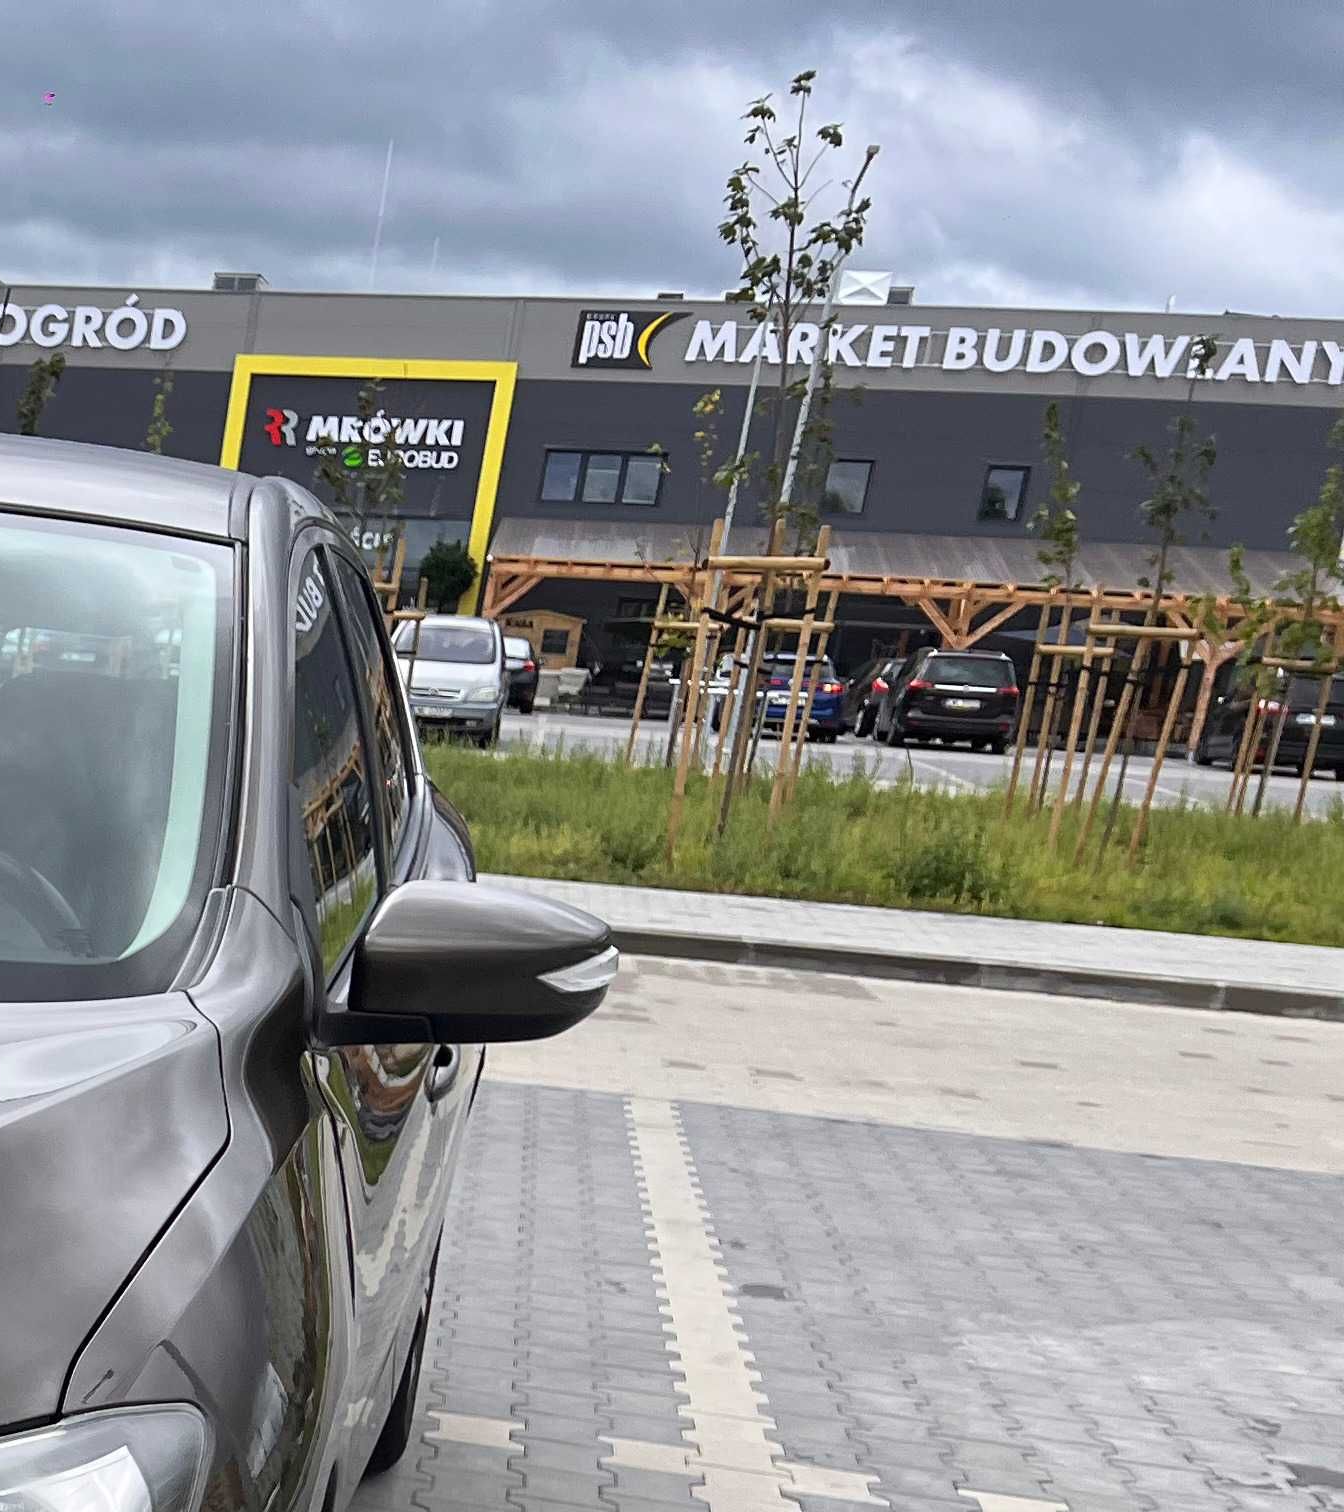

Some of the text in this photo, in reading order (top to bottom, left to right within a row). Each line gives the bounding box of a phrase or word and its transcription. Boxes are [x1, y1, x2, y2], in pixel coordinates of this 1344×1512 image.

[578, 312, 635, 364] psb
[685, 320, 931, 368] MARKET
[306, 410, 465, 446] MRÓWKI
[368, 450, 458, 469] EOBUD
